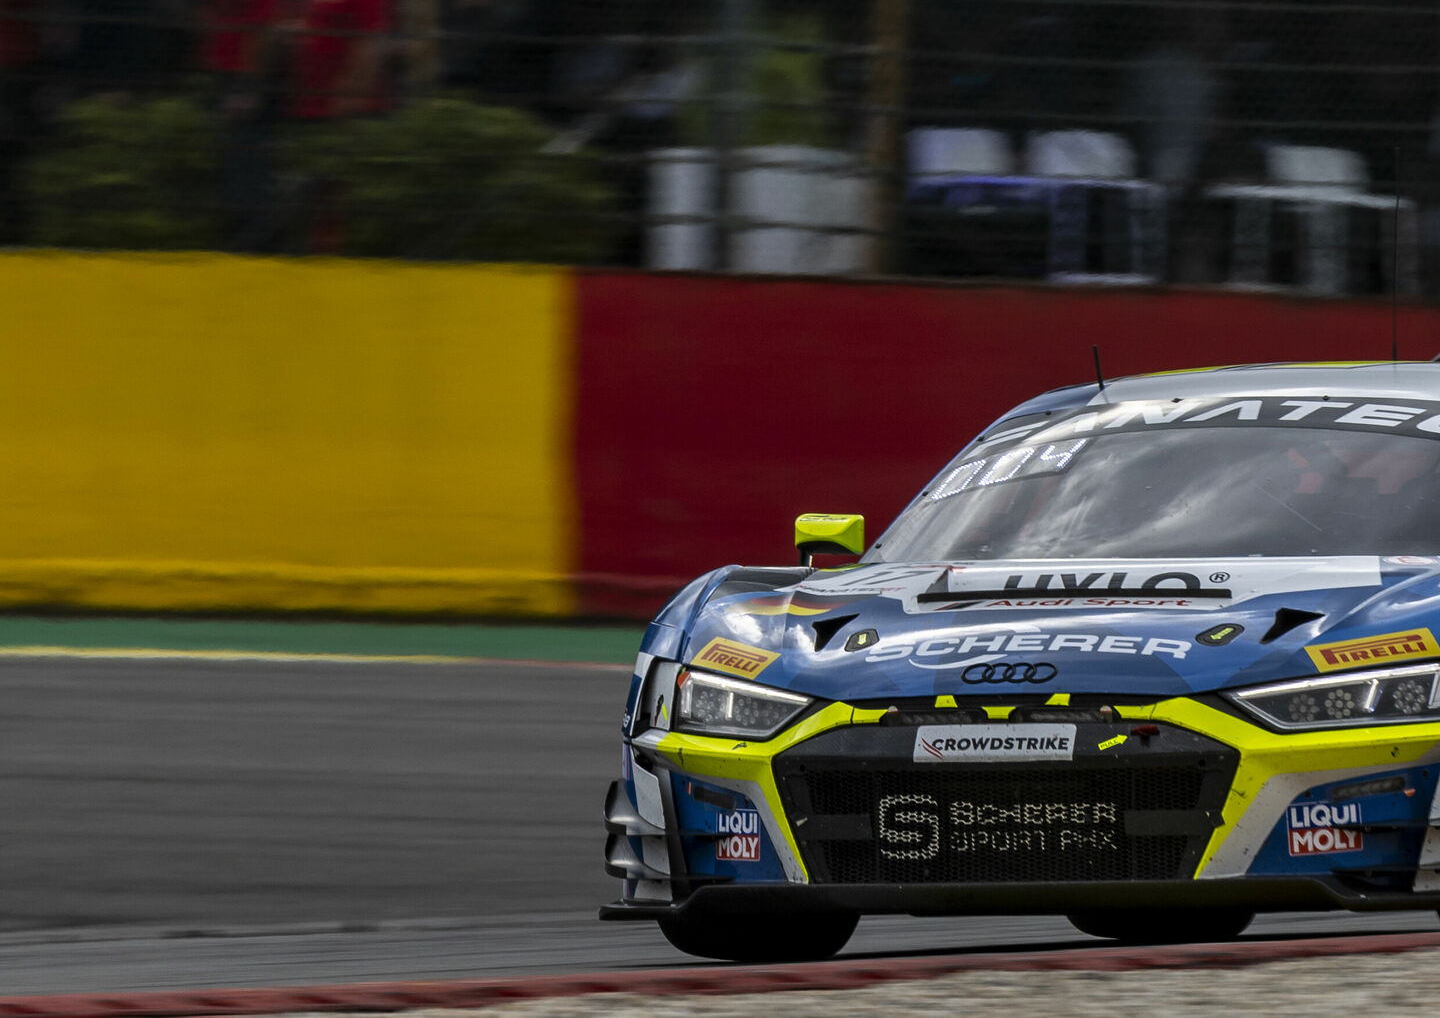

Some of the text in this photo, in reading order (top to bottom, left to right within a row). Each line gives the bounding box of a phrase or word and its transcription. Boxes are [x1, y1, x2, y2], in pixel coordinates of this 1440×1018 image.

[1083, 597, 1193, 608] Sport
[700, 642, 768, 673] PIRELLI
[865, 634, 1194, 663] SCHERER
[1320, 634, 1428, 666] PIRELLI
[930, 737, 1070, 752] CROWDSTRIKE
[718, 812, 758, 834] LIQUI
[950, 801, 1117, 825] SCHERER
[1291, 804, 1357, 828] LIQUI
[718, 836, 759, 858] MOLY
[951, 830, 1046, 852] SPORT
[1292, 828, 1357, 853] MOLY
